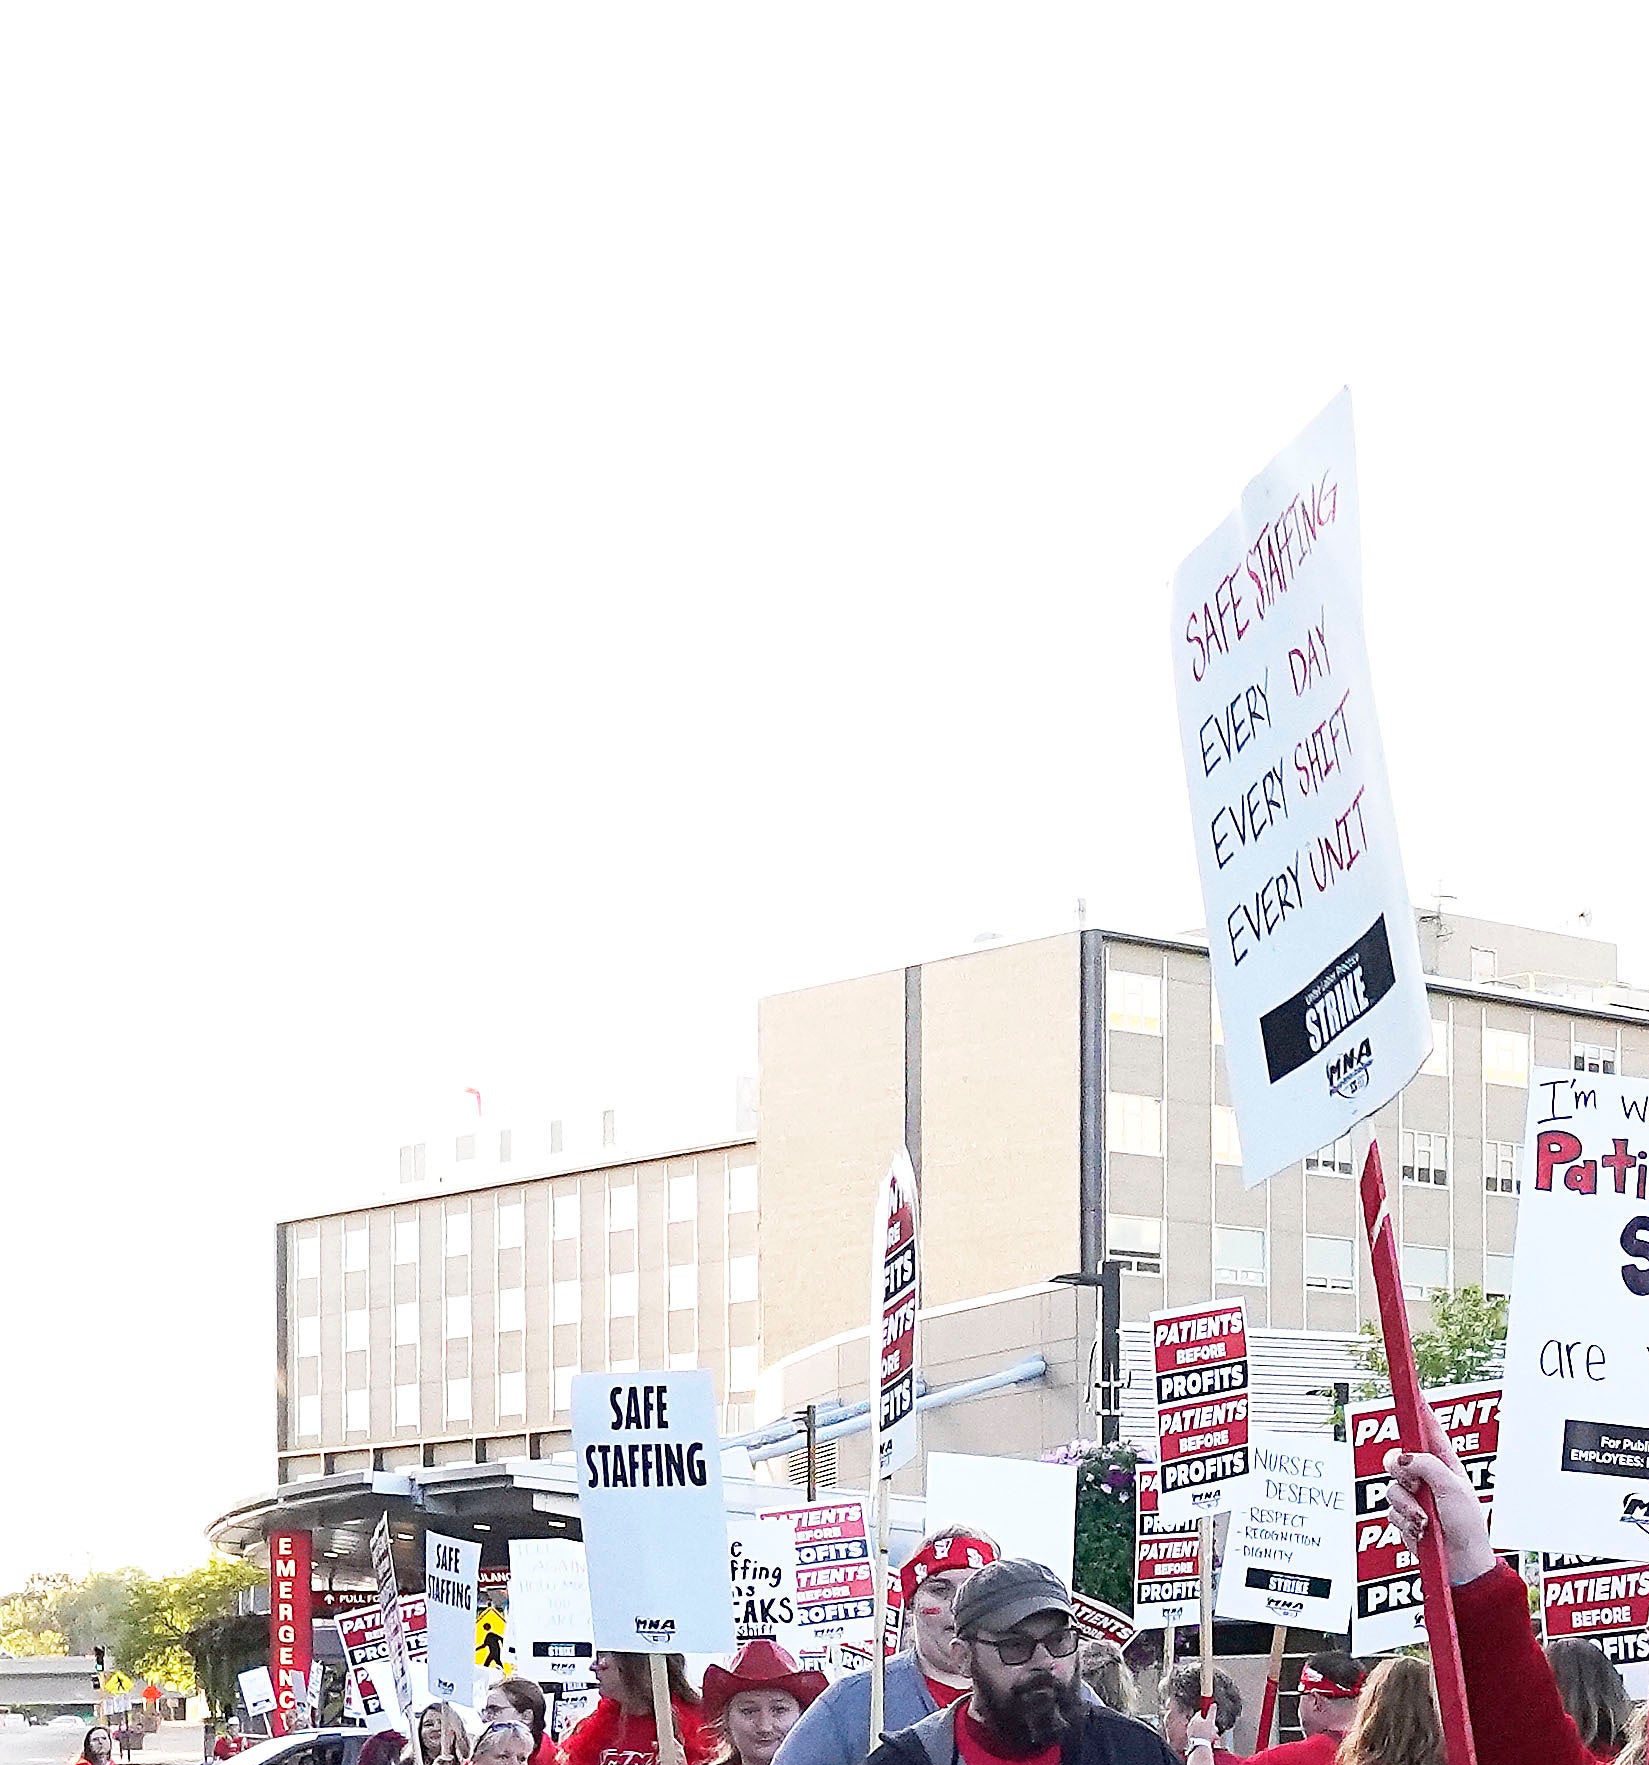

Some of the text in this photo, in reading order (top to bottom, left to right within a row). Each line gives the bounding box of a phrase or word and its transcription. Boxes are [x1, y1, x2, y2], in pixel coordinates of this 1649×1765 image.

[1186, 470, 1339, 682] SAFE STAFFING
[1200, 605, 1335, 777] EVERY DAY
[1210, 689, 1353, 870] EVERY SHIFT
[1227, 785, 1369, 967] EVERY UNIT
[1304, 964, 1370, 1053] STRIKE
[1537, 1078, 1597, 1124] I'm
[1154, 1311, 1244, 1348] PATIENTS
[1176, 1342, 1227, 1366] BEFORE
[1540, 1338, 1606, 1382] are
[1161, 1363, 1245, 1400] PROFITS
[609, 1384, 669, 1431] SAFE
[1159, 1398, 1249, 1437] PATIENTS
[1355, 1398, 1502, 1448] PAENT
[1179, 1428, 1230, 1453] BEFORE
[1600, 1435, 1621, 1450] For
[585, 1441, 708, 1489] STAFFING
[1165, 1450, 1246, 1486] PROFITS
[1253, 1448, 1324, 1478] NURSES
[1265, 1478, 1346, 1511] DESERVE
[436, 1543, 461, 1575] SAFE
[428, 1574, 472, 1611] STAFFING
[1268, 1577, 1310, 1596] STRIKE
[733, 1597, 794, 1624] AKS
[1571, 1605, 1632, 1629] BEFORE
